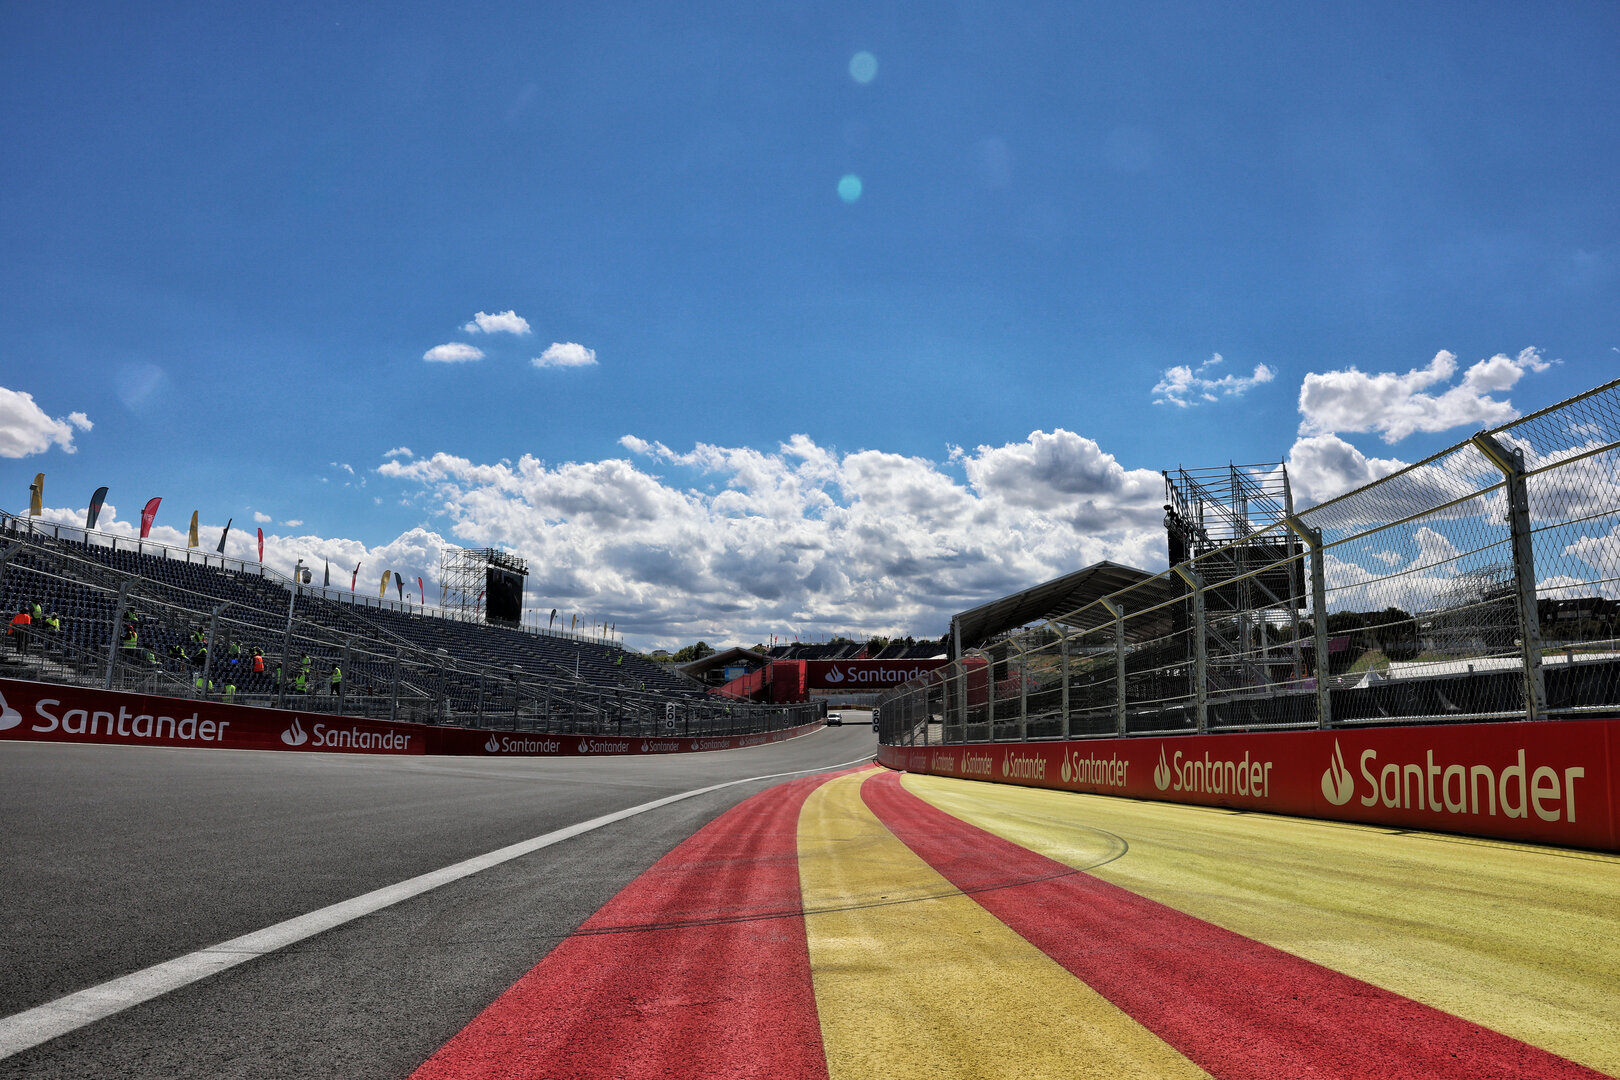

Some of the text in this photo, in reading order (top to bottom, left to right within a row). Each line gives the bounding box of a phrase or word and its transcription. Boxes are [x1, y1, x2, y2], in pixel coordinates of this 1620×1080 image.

[31, 698, 230, 742] Santander
[666, 705, 675, 728] 200
[311, 722, 411, 750] Santander
[501, 736, 560, 753] Santander
[589, 739, 629, 753] Santander
[650, 740, 680, 752] Santander
[700, 740, 730, 750] Santander
[966, 751, 993, 775] Santander
[1009, 751, 1047, 780] Santander
[1072, 751, 1129, 787] Santander
[1172, 750, 1273, 798] Santander
[1359, 748, 1585, 823] Santander
